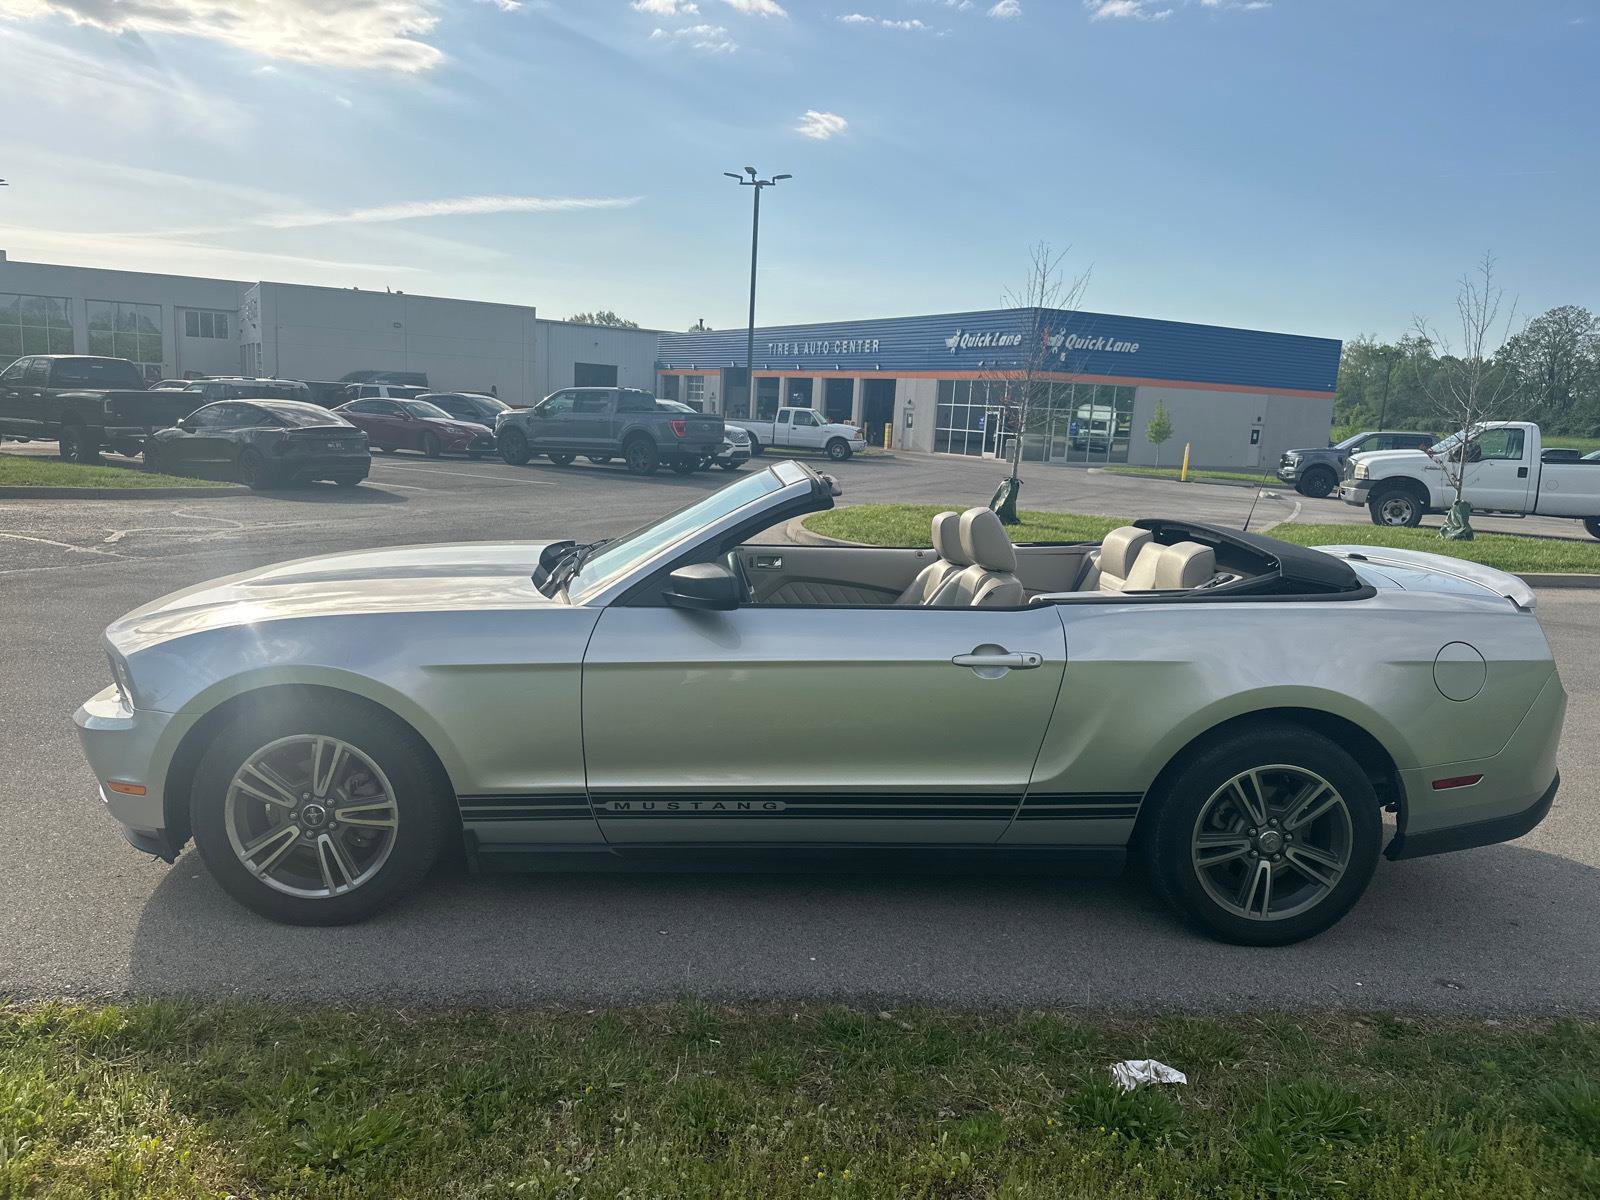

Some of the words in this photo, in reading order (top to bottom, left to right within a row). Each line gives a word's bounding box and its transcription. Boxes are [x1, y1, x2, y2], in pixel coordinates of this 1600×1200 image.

[768, 343, 789, 355] TIRE
[793, 343, 799, 355] &
[803, 341, 829, 354] AUTO
[834, 339, 879, 354] CENTER
[960, 332, 992, 349] Quick
[991, 332, 1022, 347] Lane
[1065, 334, 1106, 351] Quick
[1104, 337, 1140, 353] Lane
[614, 802, 777, 810] MUSTANG
